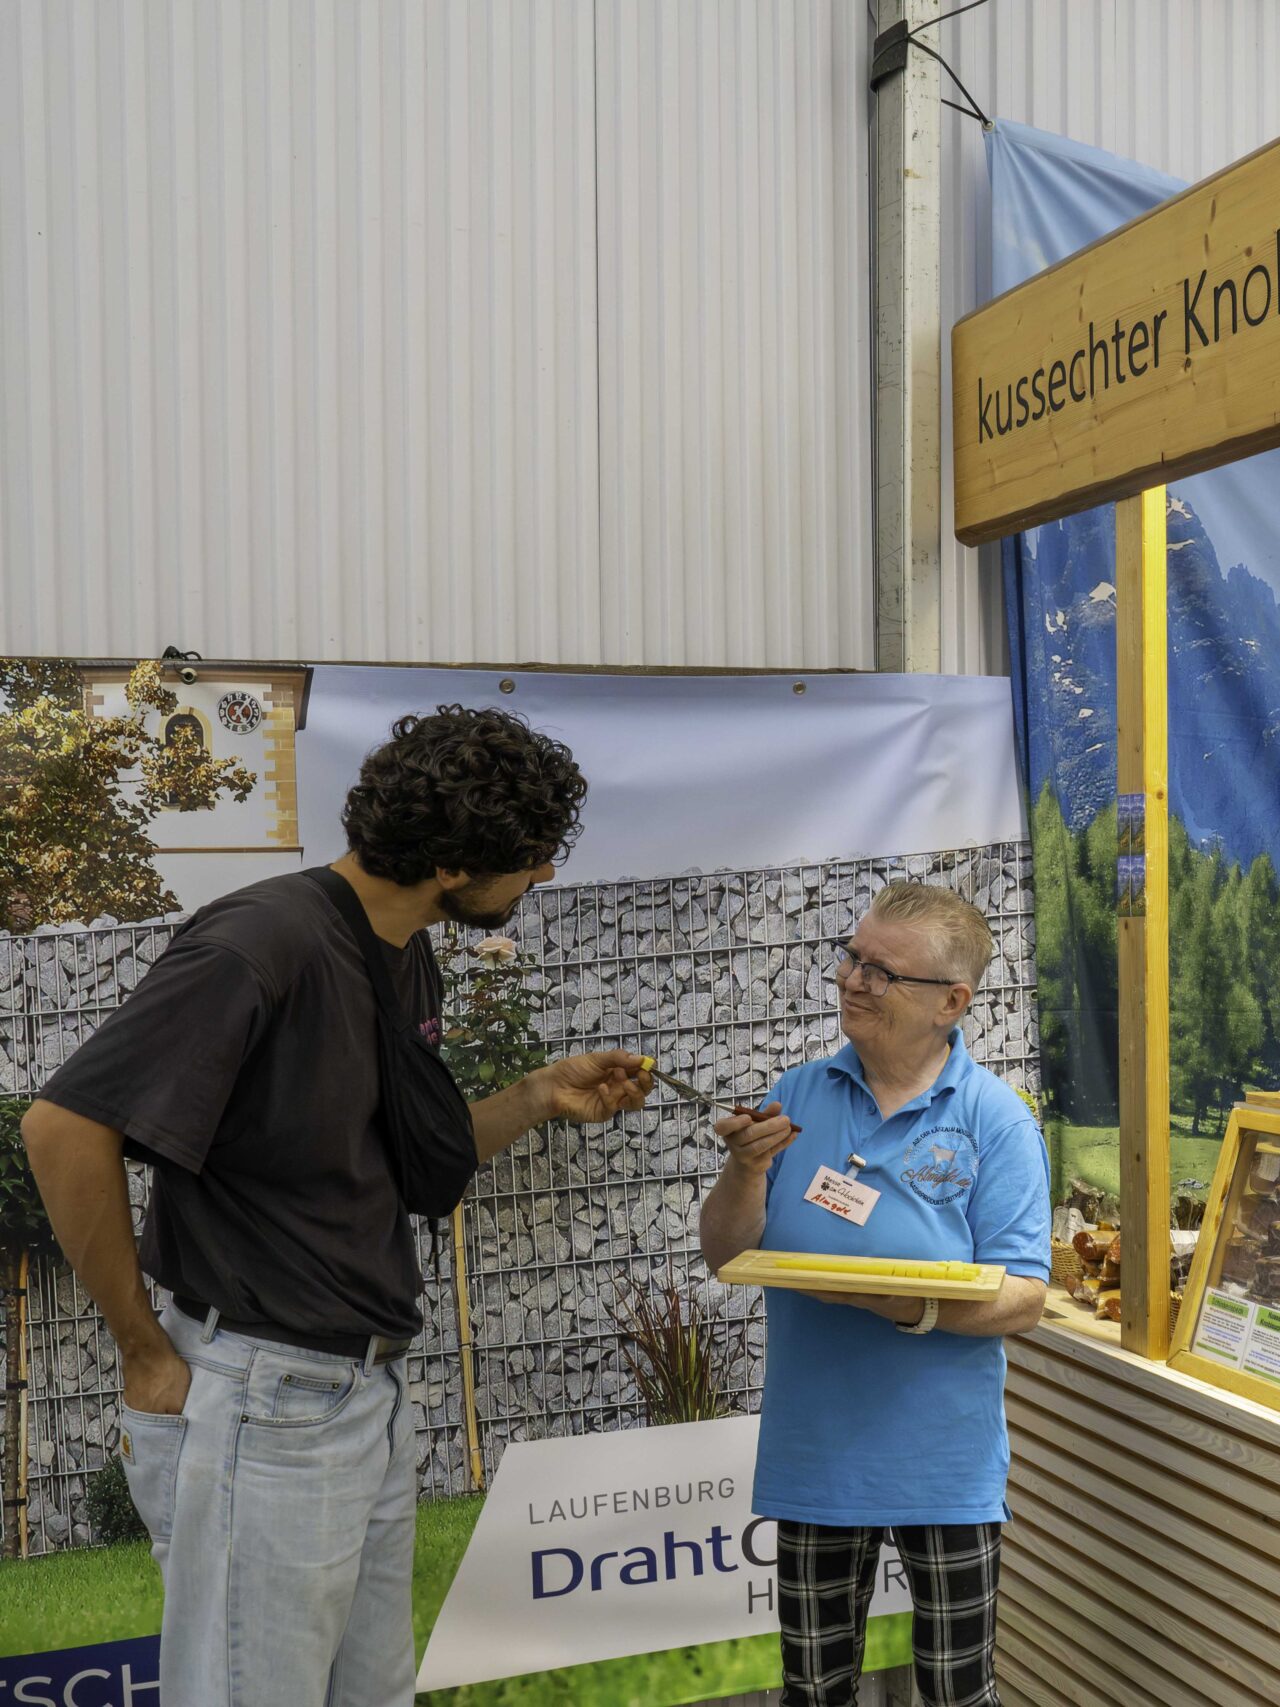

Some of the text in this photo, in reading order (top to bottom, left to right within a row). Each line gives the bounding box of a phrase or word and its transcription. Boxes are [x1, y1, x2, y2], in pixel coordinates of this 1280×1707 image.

[978, 310, 1167, 444] kussechter
[528, 1477, 736, 1526] LAUFENBURG
[0, 1663, 160, 1707] SCH
